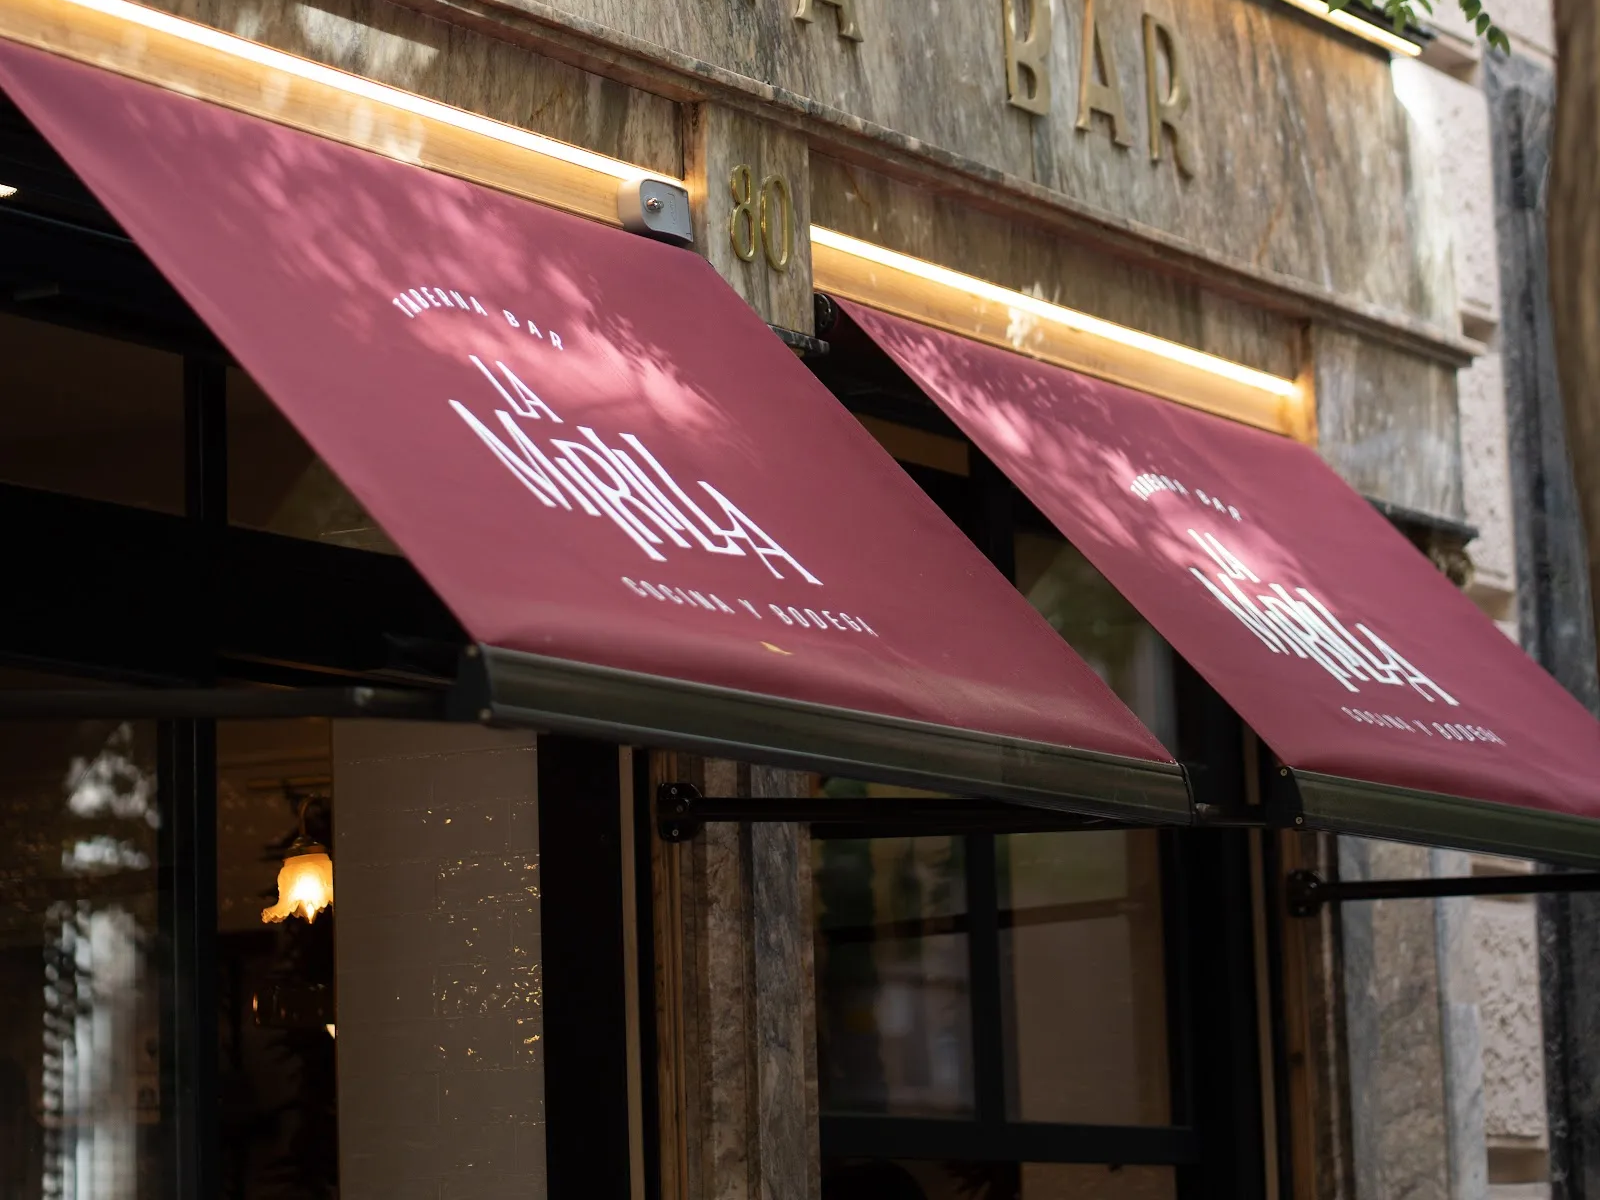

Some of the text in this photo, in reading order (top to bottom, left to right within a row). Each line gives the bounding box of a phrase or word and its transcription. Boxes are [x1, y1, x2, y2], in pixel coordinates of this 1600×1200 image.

[730, 163, 790, 272] 80
[392, 286, 564, 350] TABERNA BAR
[468, 354, 564, 423] LA
[1187, 528, 1261, 583] LA
[621, 576, 879, 637] COCINA Y BODEGA
